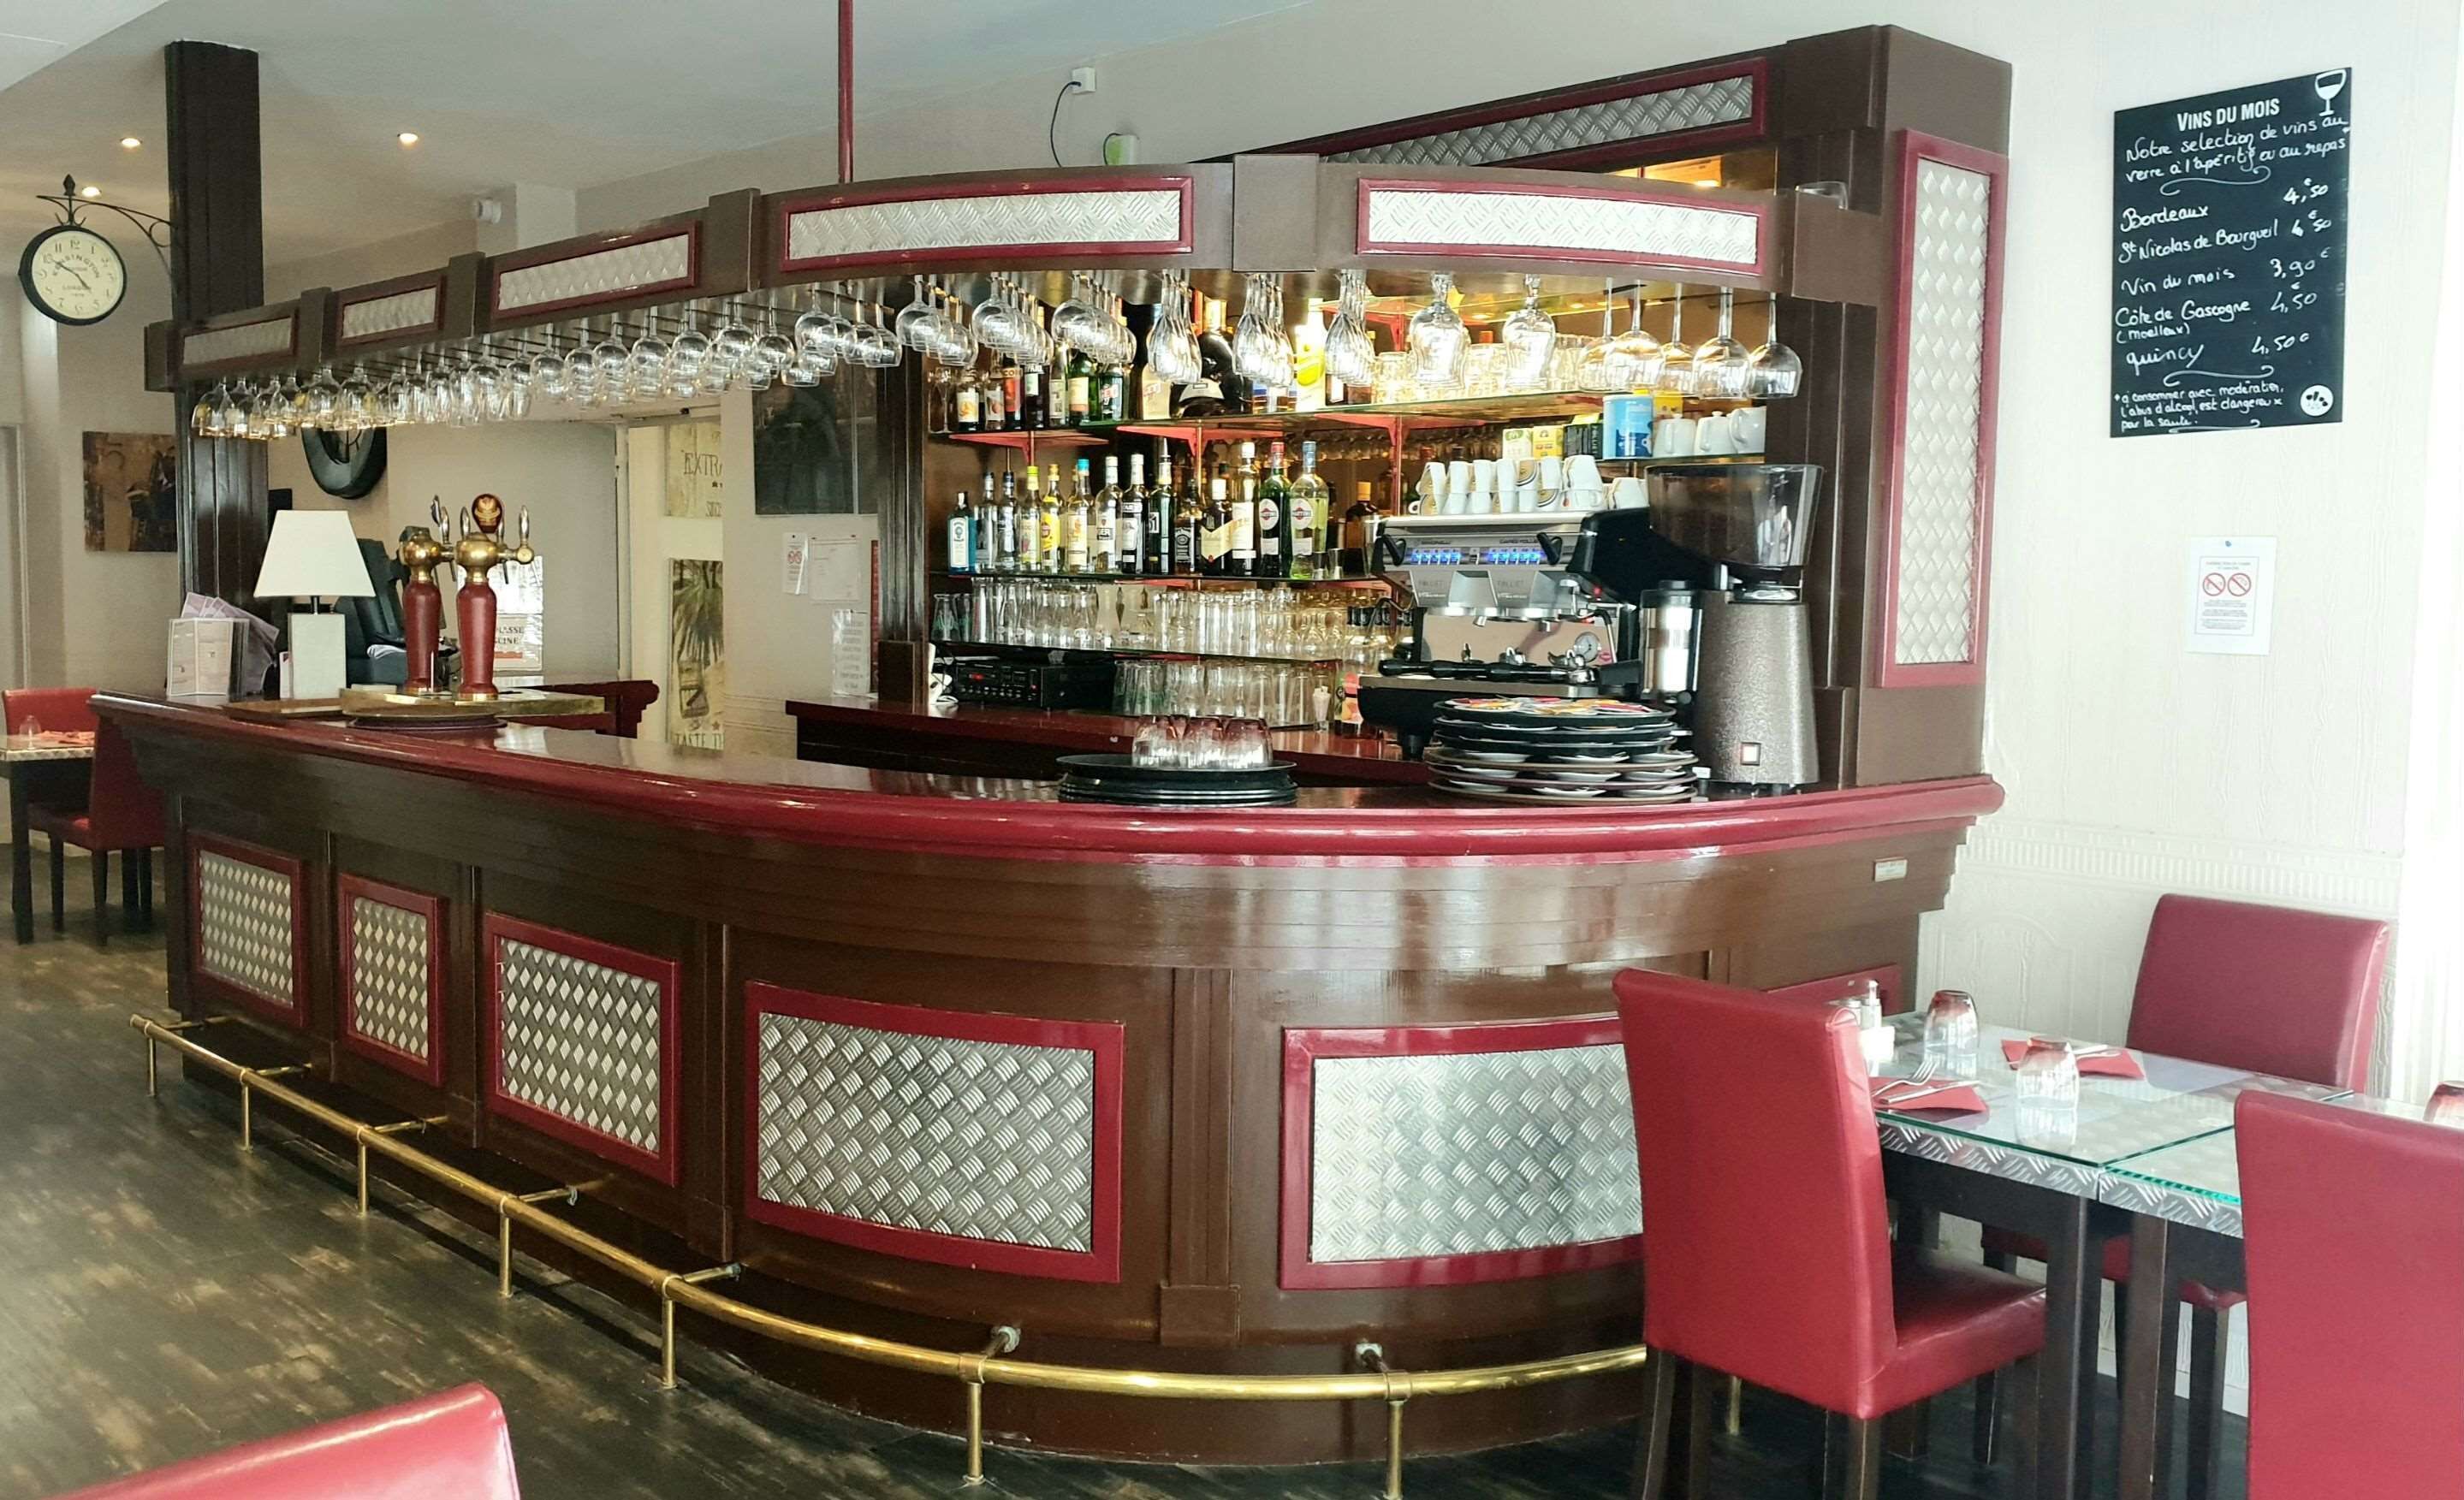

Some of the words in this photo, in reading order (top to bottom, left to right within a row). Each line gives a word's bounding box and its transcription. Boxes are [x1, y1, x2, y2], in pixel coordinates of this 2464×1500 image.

[2176, 110, 2212, 131] VINS
[2216, 105, 2237, 125] DU
[2241, 98, 2280, 121] MOIS
[2126, 136, 2173, 163] Notre
[2259, 123, 2278, 140] de
[2283, 121, 2318, 135] vins
[2321, 116, 2349, 127] au
[2125, 168, 2165, 183] verre
[2169, 161, 2182, 175] à
[2278, 146, 2301, 158] au
[2303, 138, 2347, 158] repas
[2120, 206, 2209, 232] Bordeaux
[2118, 240, 2137, 264] St
[2139, 238, 2192, 260] Nicolas
[2193, 234, 2212, 249] de
[2121, 277, 2157, 295] Vin
[2163, 274, 2182, 289] du
[2188, 267, 2235, 286] mois
[2154, 307, 2174, 322] de
[2181, 299, 2252, 323] Gascogne
[2131, 389, 2185, 402] consommer
[2188, 388, 2216, 400] avec
